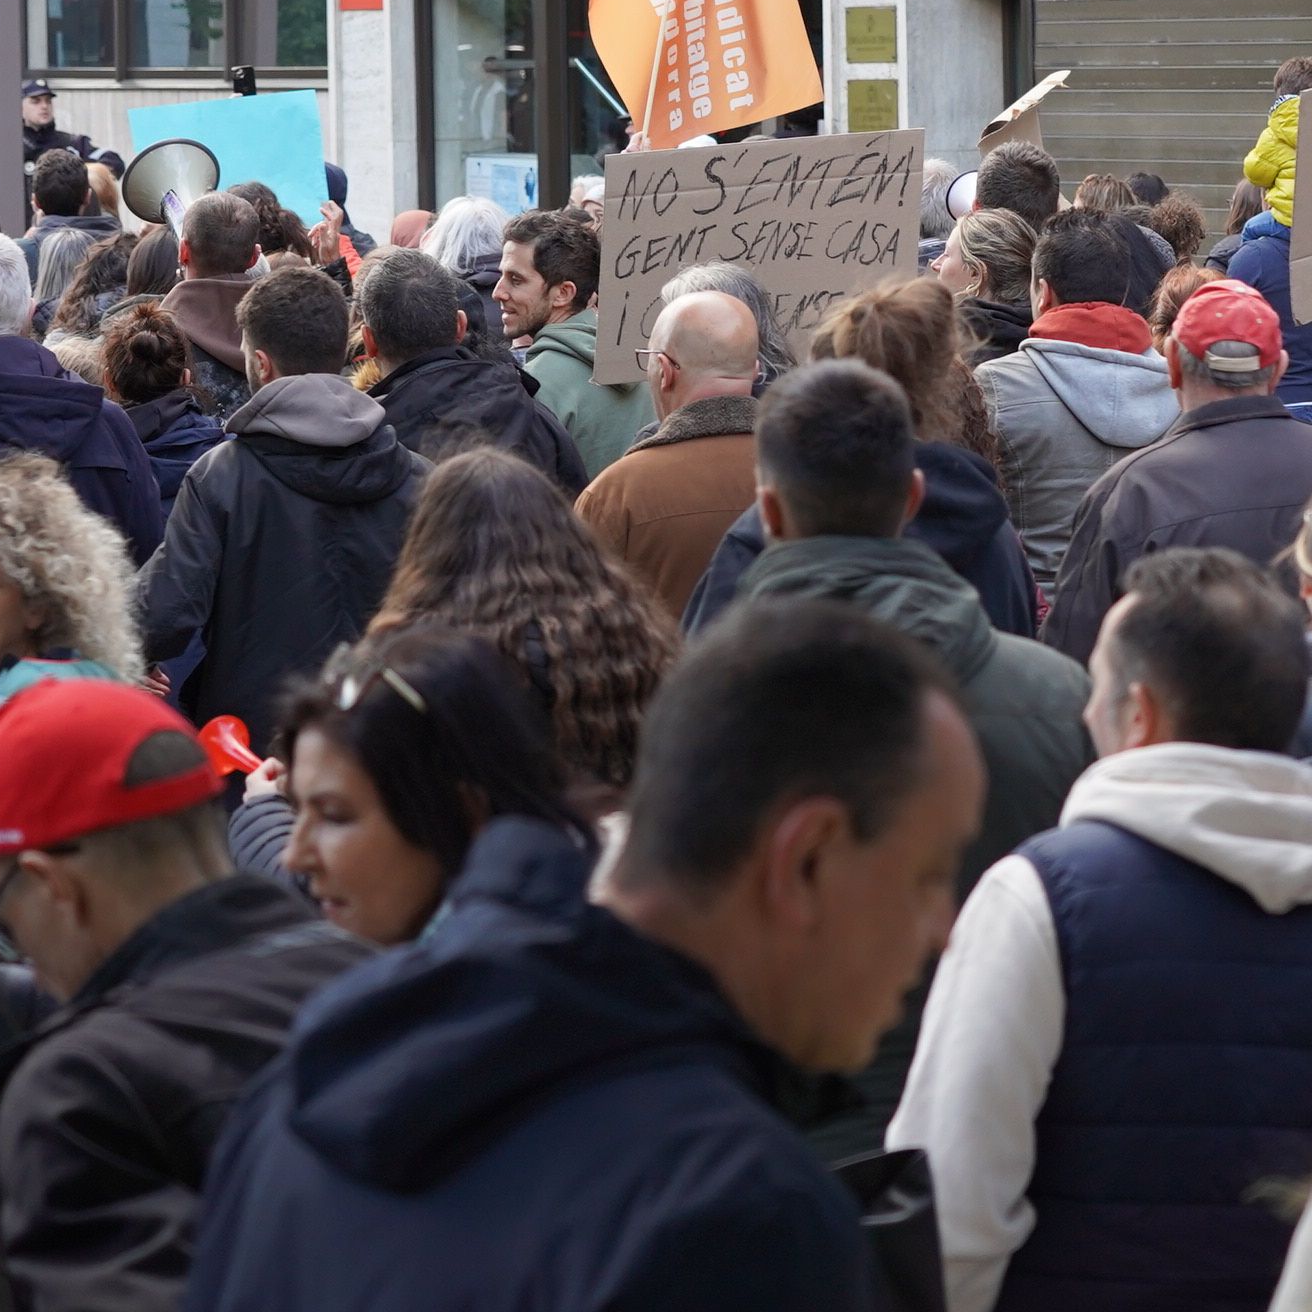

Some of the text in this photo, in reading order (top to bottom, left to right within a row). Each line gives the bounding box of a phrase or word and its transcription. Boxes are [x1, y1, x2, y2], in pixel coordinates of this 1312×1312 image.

[618, 167, 679, 221] NO
[615, 219, 901, 279] GENT SENSE CASA
